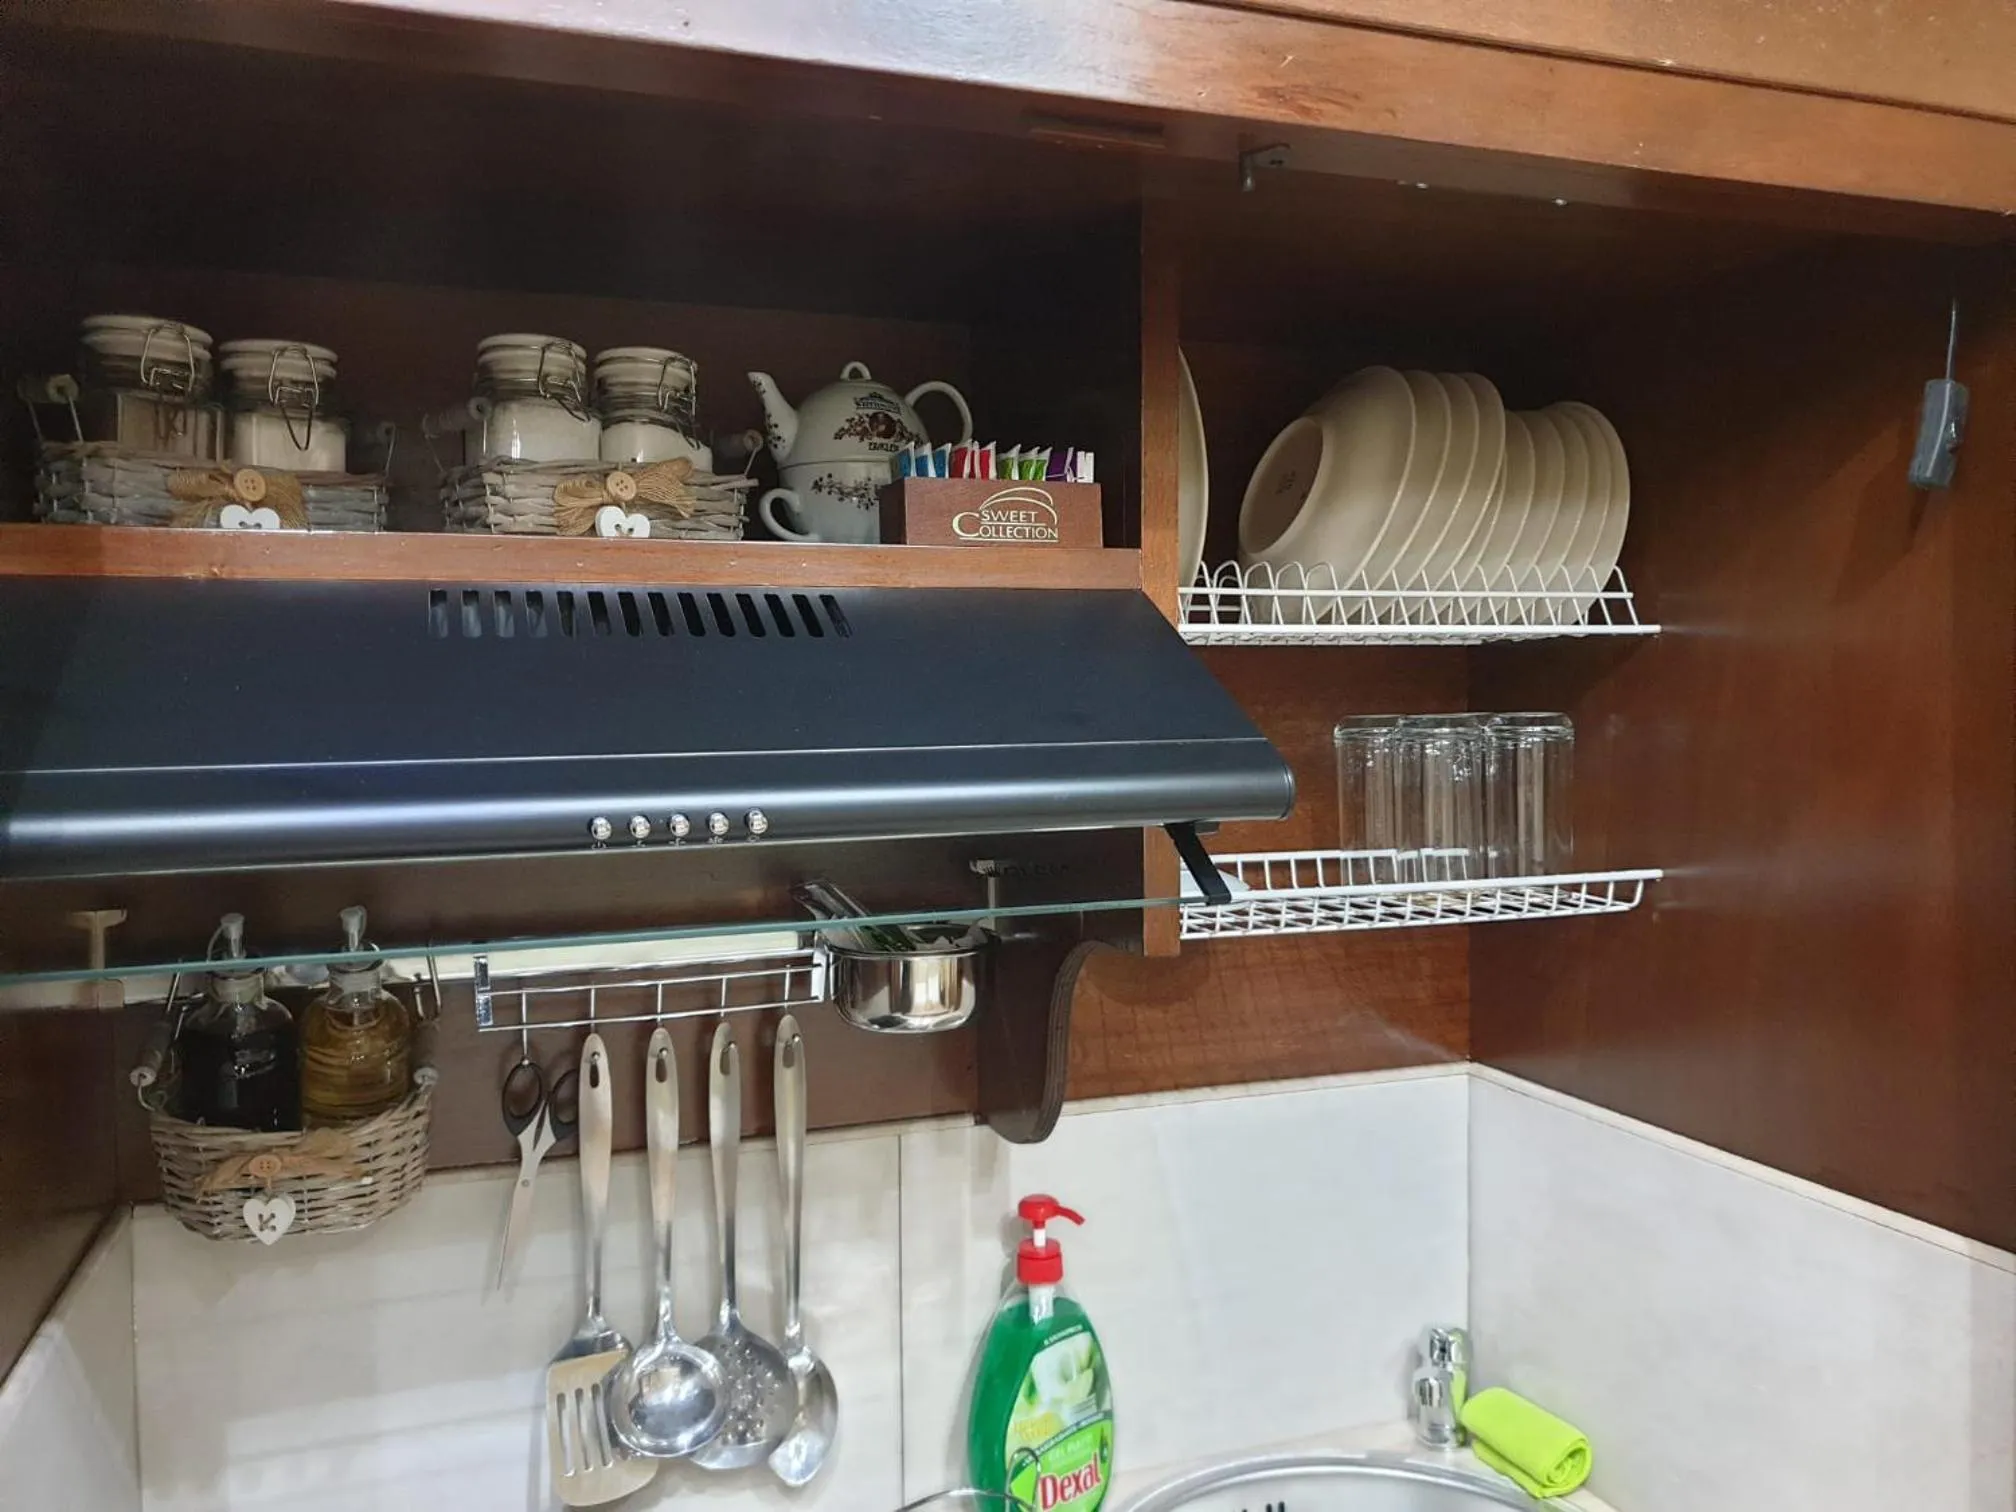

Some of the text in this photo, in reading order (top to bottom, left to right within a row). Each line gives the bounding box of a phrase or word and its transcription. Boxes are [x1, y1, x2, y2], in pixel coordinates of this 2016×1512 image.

[952, 511, 1059, 539] COLLECTION
[981, 510, 1038, 523] SWEET
[1039, 1452, 1101, 1511] Dexal
